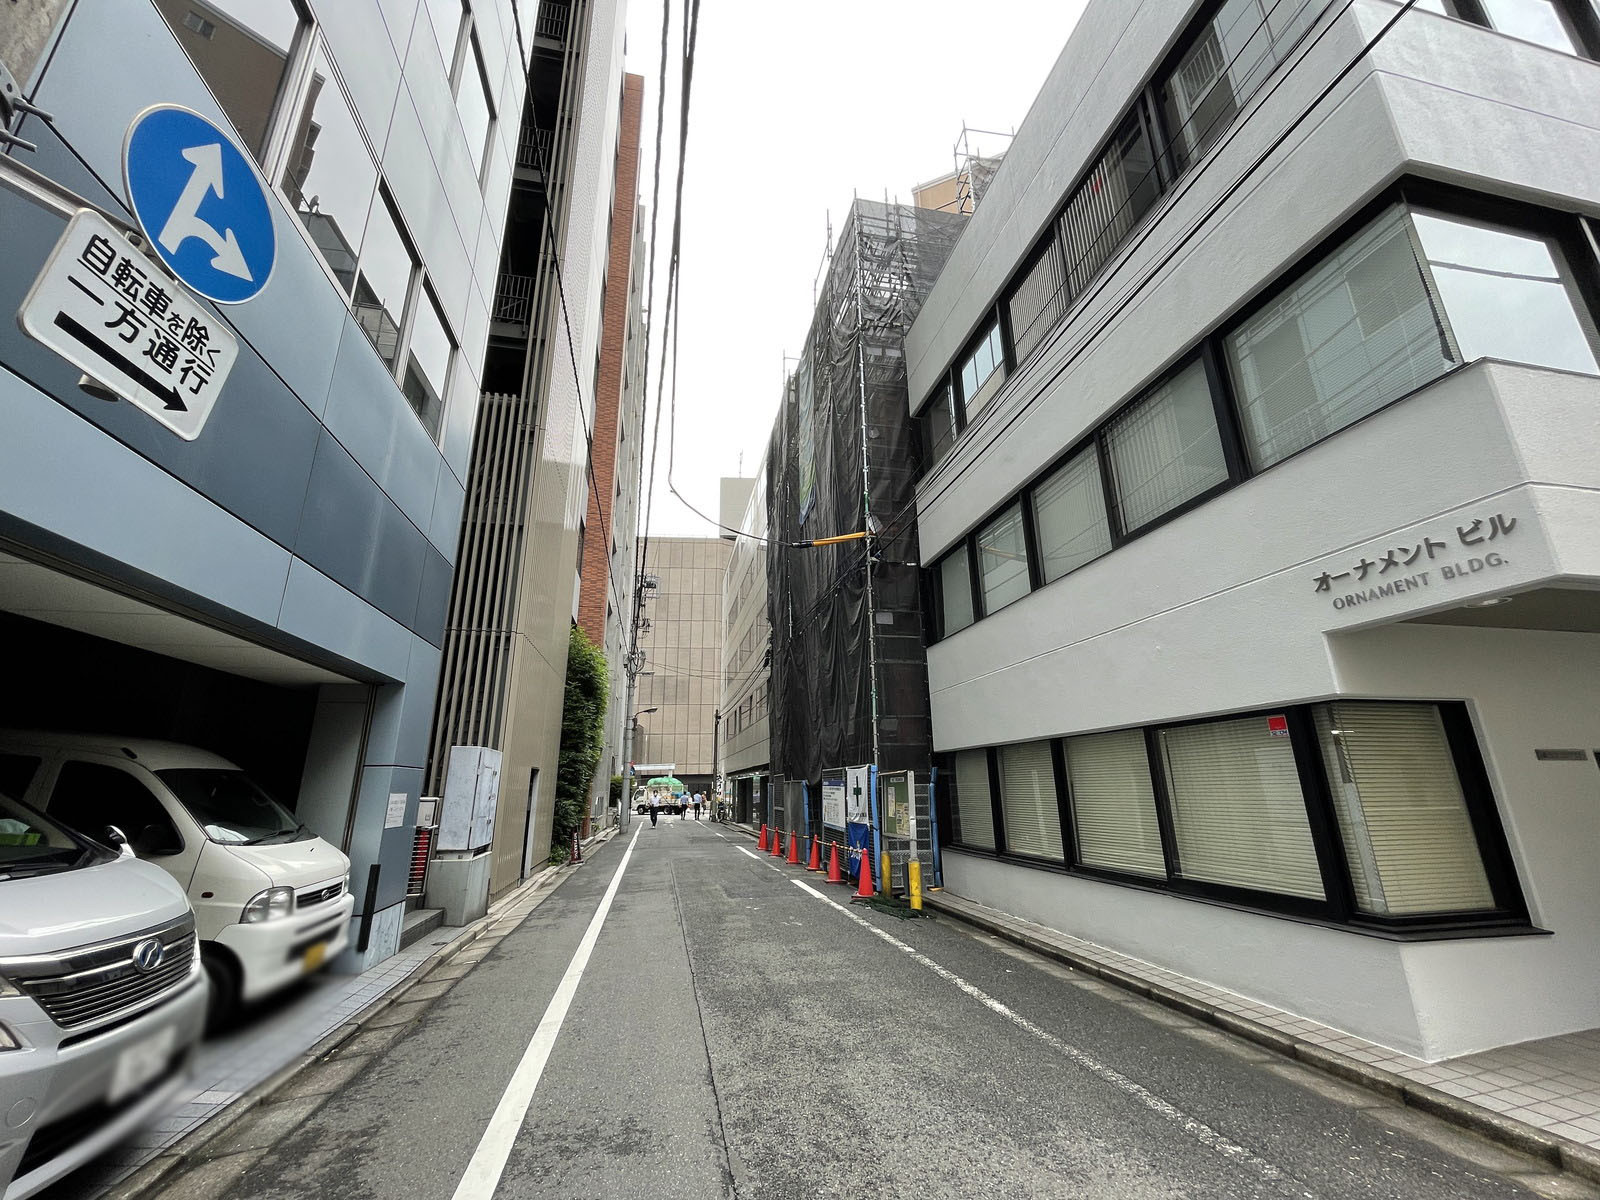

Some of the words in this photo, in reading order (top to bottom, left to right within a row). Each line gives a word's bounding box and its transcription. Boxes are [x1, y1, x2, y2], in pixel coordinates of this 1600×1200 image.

[67, 274, 211, 395] 一方通行
[82, 234, 221, 368] 自転車を除く
[1313, 537, 1447, 593] オーナメント
[1456, 513, 1517, 546] ビル
[1332, 571, 1430, 610] ORNAMENT
[1440, 552, 1509, 581] BLDG.
